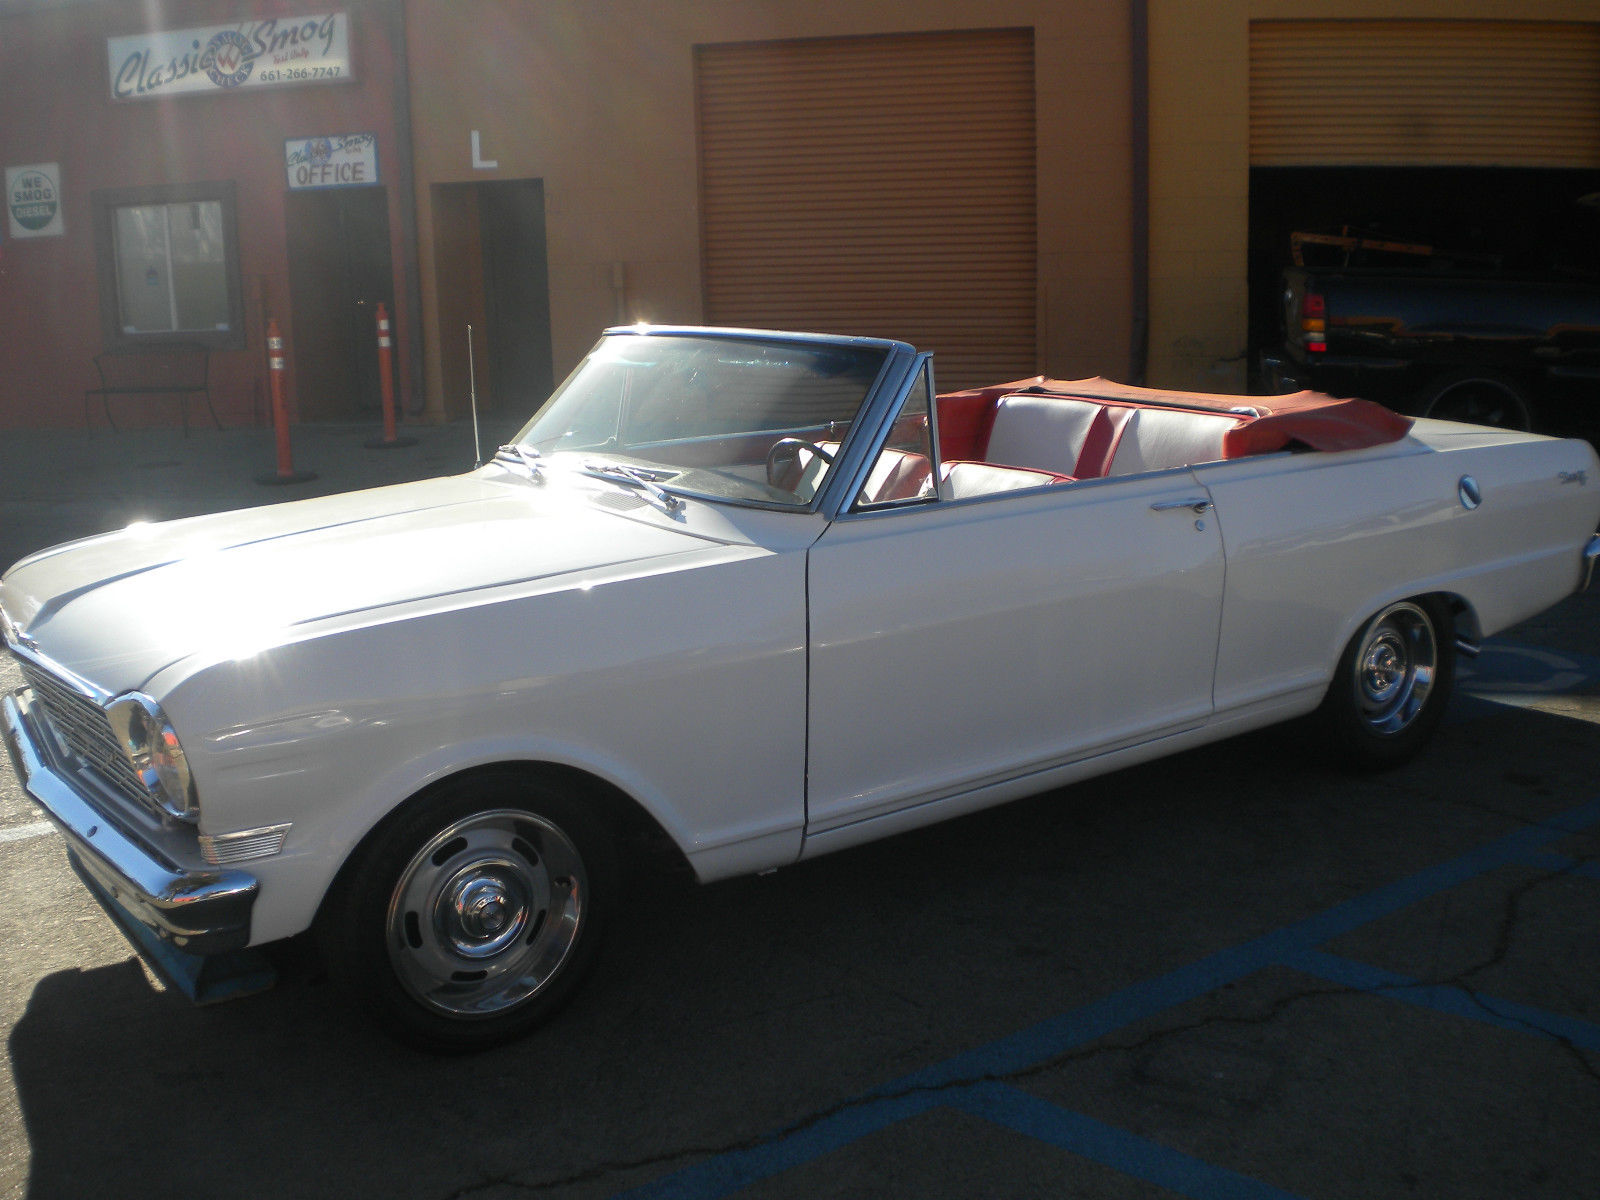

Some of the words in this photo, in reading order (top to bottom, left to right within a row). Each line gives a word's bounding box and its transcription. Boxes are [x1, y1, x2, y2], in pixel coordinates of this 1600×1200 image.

[114, 39, 214, 97] Classic
[242, 13, 336, 62] Smog
[260, 66, 341, 81] 661-266-7747
[471, 129, 498, 169] L
[22, 176, 42, 188] WE
[297, 162, 364, 185] OFFICE
[15, 188, 51, 202] SMOG
